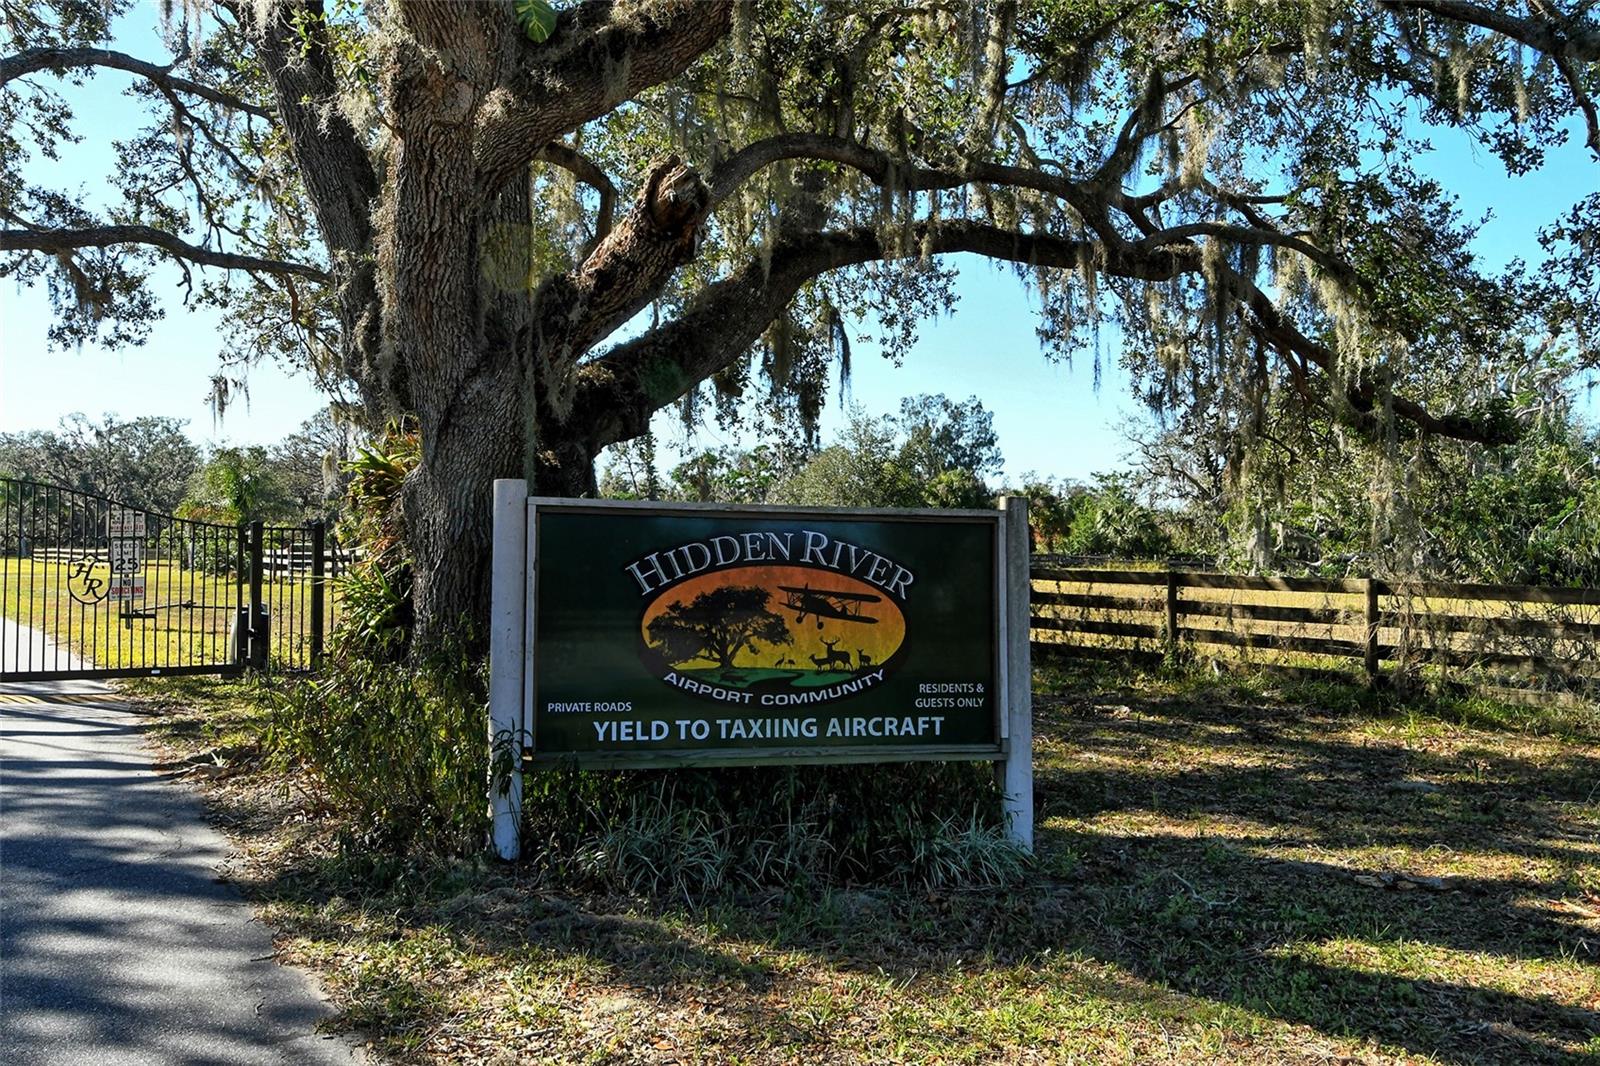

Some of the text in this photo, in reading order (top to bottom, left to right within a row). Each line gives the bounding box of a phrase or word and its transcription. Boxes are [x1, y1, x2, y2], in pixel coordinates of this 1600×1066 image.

[115, 558, 139, 571] 25
[625, 530, 916, 600] HIDDEN RIVER
[664, 669, 886, 706] AIRPORT COMMUNITY
[919, 683, 985, 694] RESIDENTS &
[547, 702, 632, 713] PRIVATE ROADS
[915, 697, 985, 708] GUESTS ONLY
[593, 716, 945, 741] YIELD TO TAXIING AIRCRAFT
